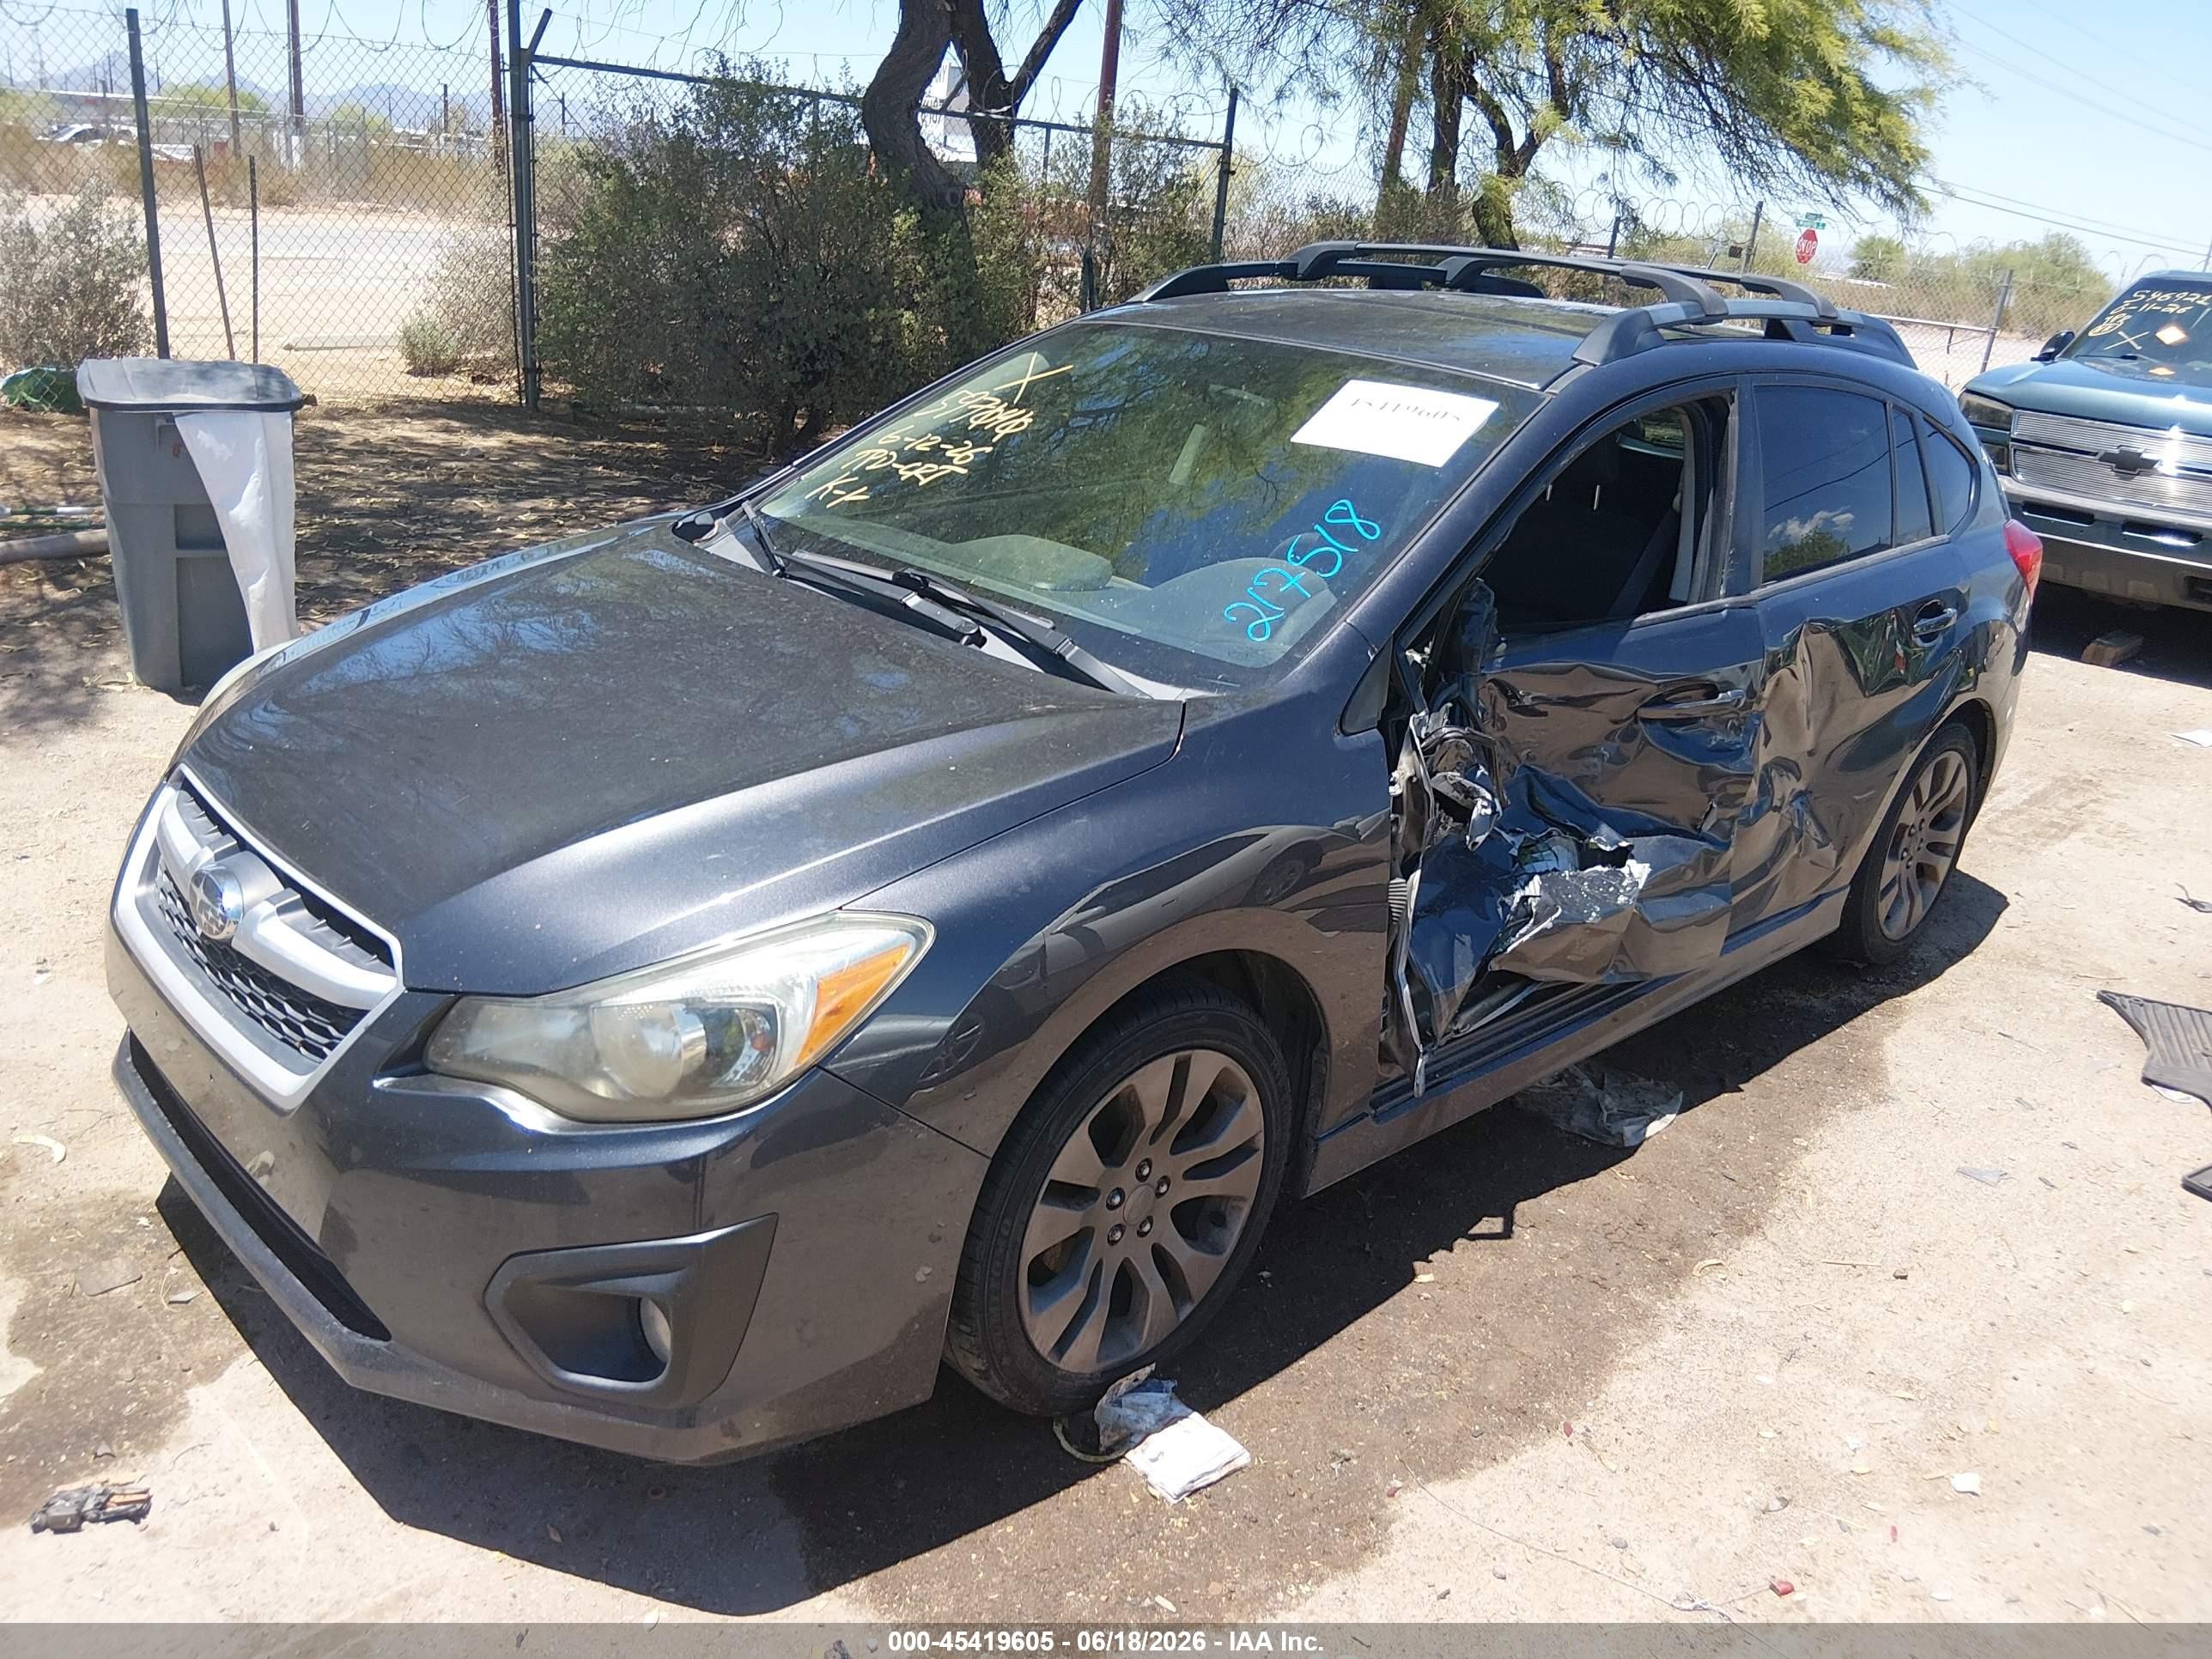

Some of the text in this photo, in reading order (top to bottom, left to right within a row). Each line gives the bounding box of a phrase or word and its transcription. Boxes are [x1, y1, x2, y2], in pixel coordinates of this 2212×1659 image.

[1796, 238, 1817, 256] STOP
[878, 424, 994, 465] 6-12-26
[1222, 499, 1382, 642] 217518
